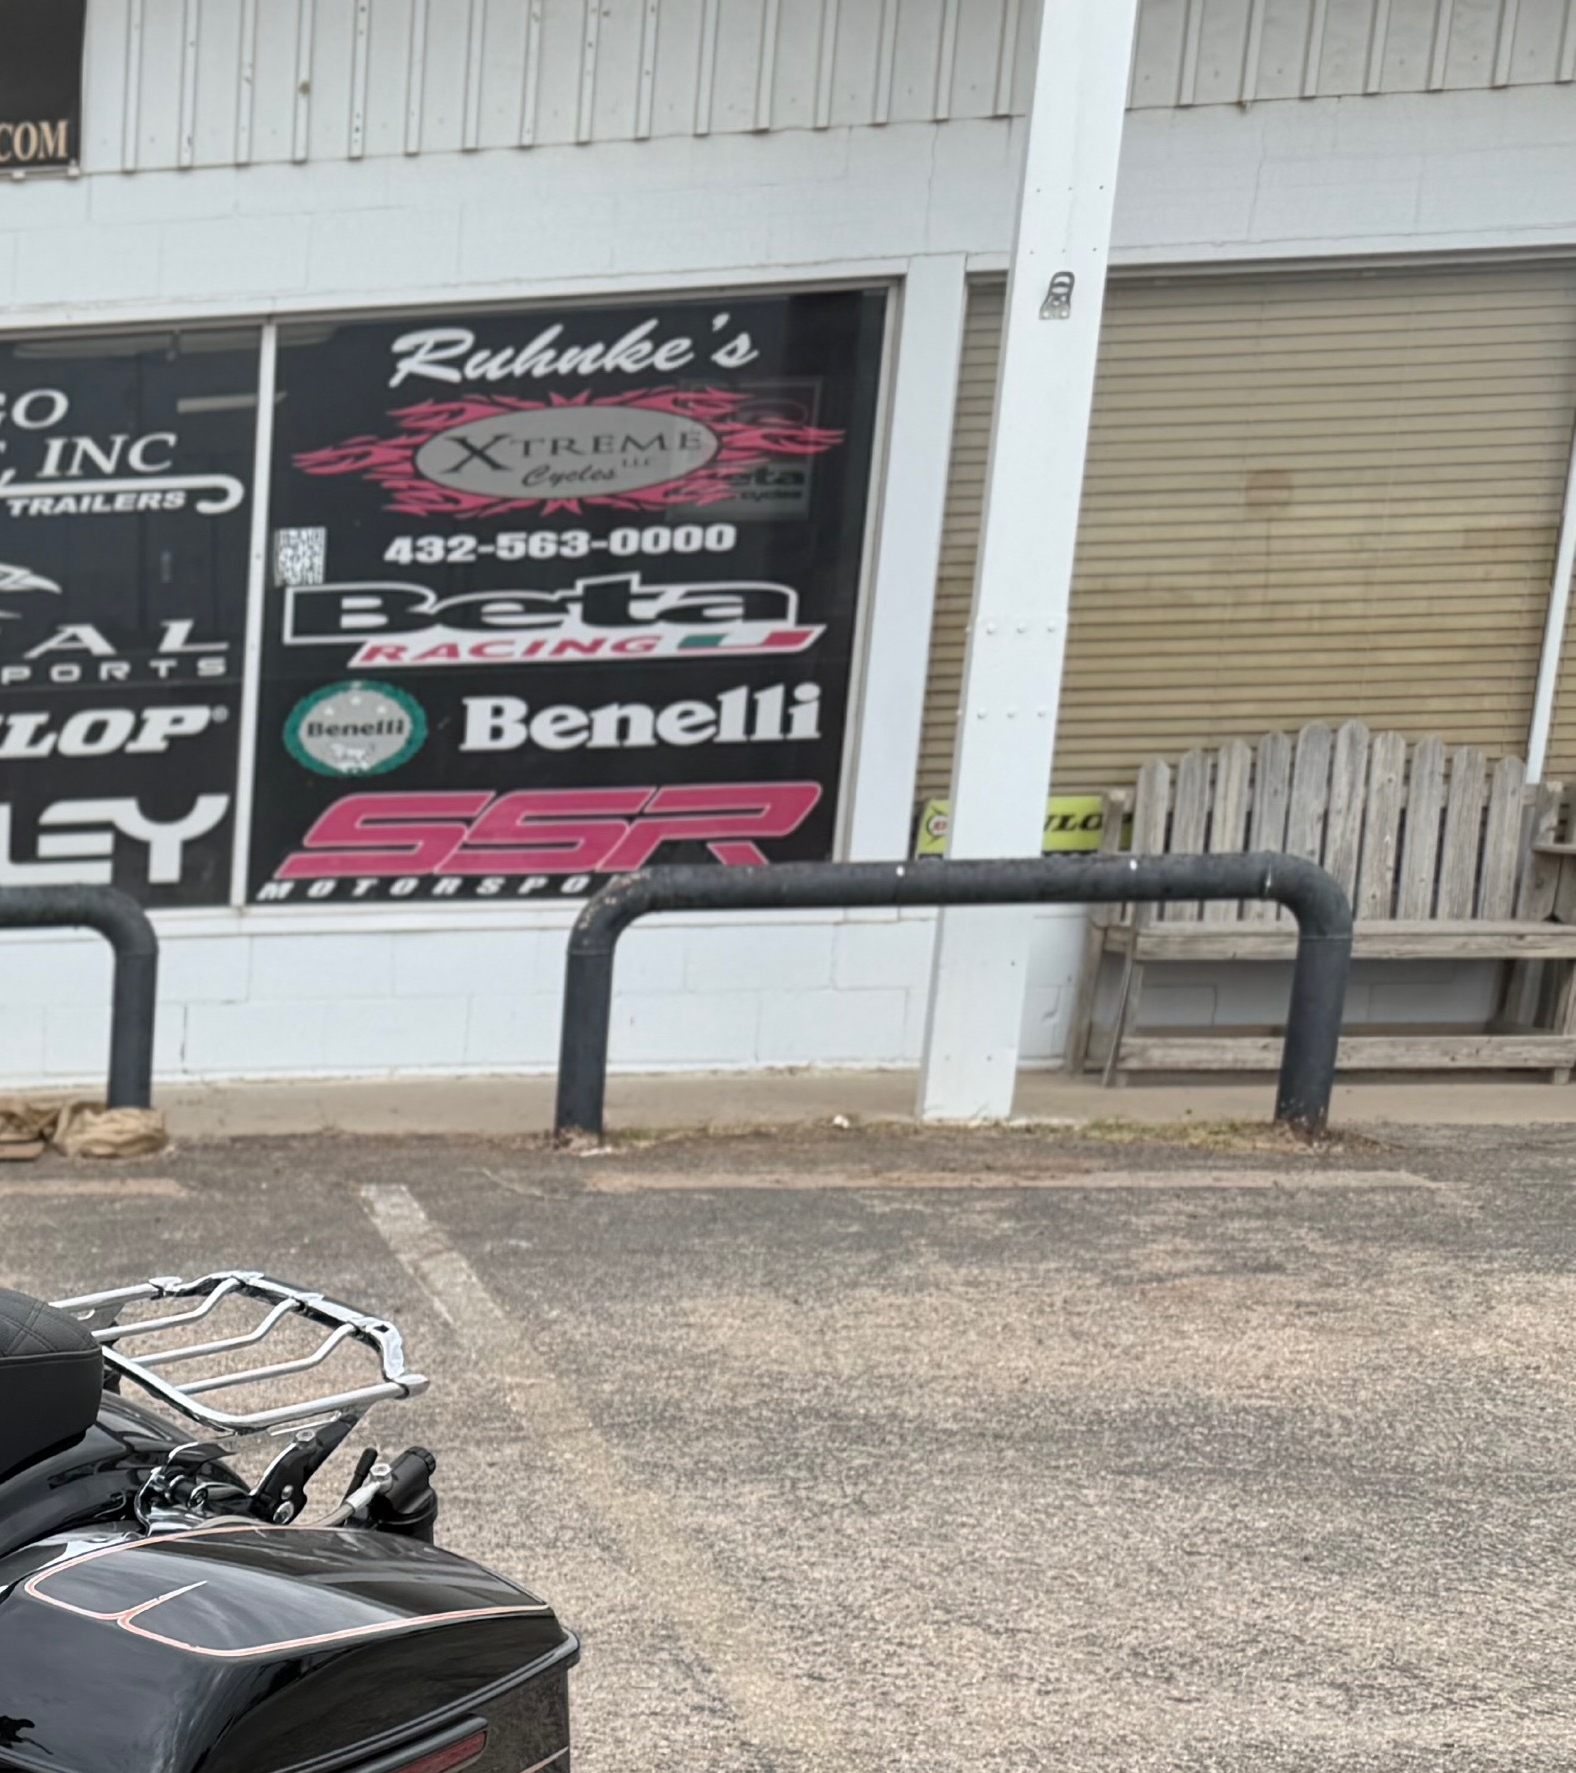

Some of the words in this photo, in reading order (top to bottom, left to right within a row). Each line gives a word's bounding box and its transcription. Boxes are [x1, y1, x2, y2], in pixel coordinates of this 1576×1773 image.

[389, 314, 759, 387] Ruhnke's
[36, 433, 177, 478] INC
[439, 429, 704, 475] XTREME
[521, 464, 617, 488] Cycles
[8, 490, 186, 516] TRAILERS
[384, 524, 737, 564] 432-563-0000
[283, 572, 799, 645] Beta
[358, 634, 663, 665] RACING
[307, 718, 405, 738] Benelli
[459, 682, 821, 751] Benelli
[272, 781, 823, 878] SSR
[255, 876, 591, 900] MOTORSPO
